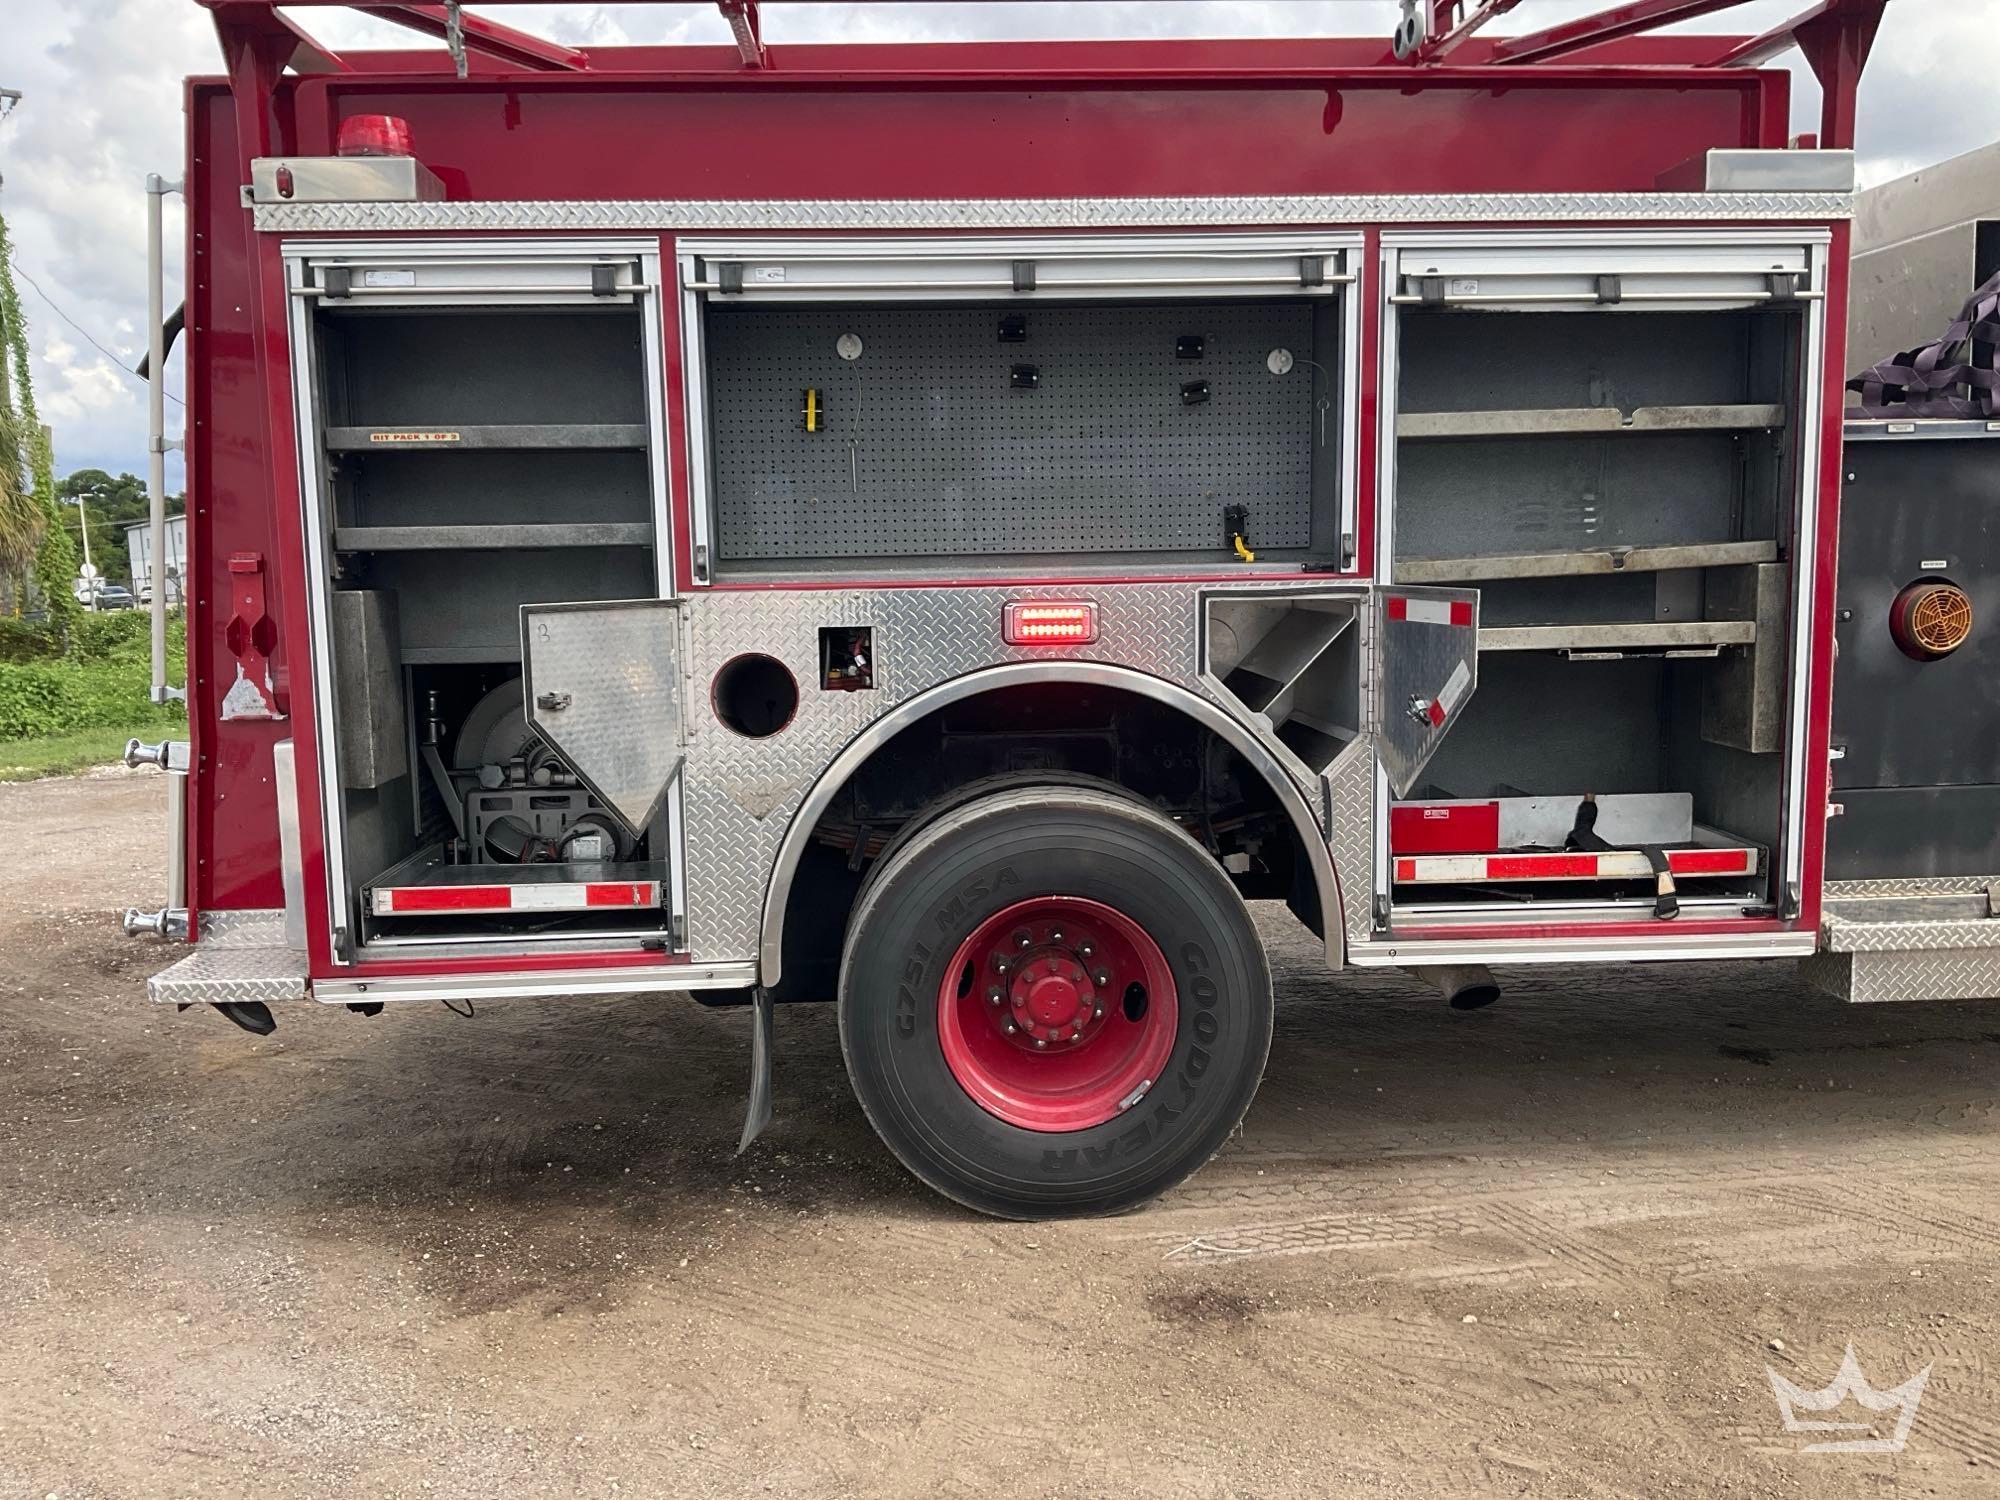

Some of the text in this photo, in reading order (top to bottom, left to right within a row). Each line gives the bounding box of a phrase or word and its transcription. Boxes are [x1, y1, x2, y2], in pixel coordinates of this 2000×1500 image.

[895, 865, 1023, 1040] G751 MSA
[1040, 941, 1219, 1173] GOODYEAR
